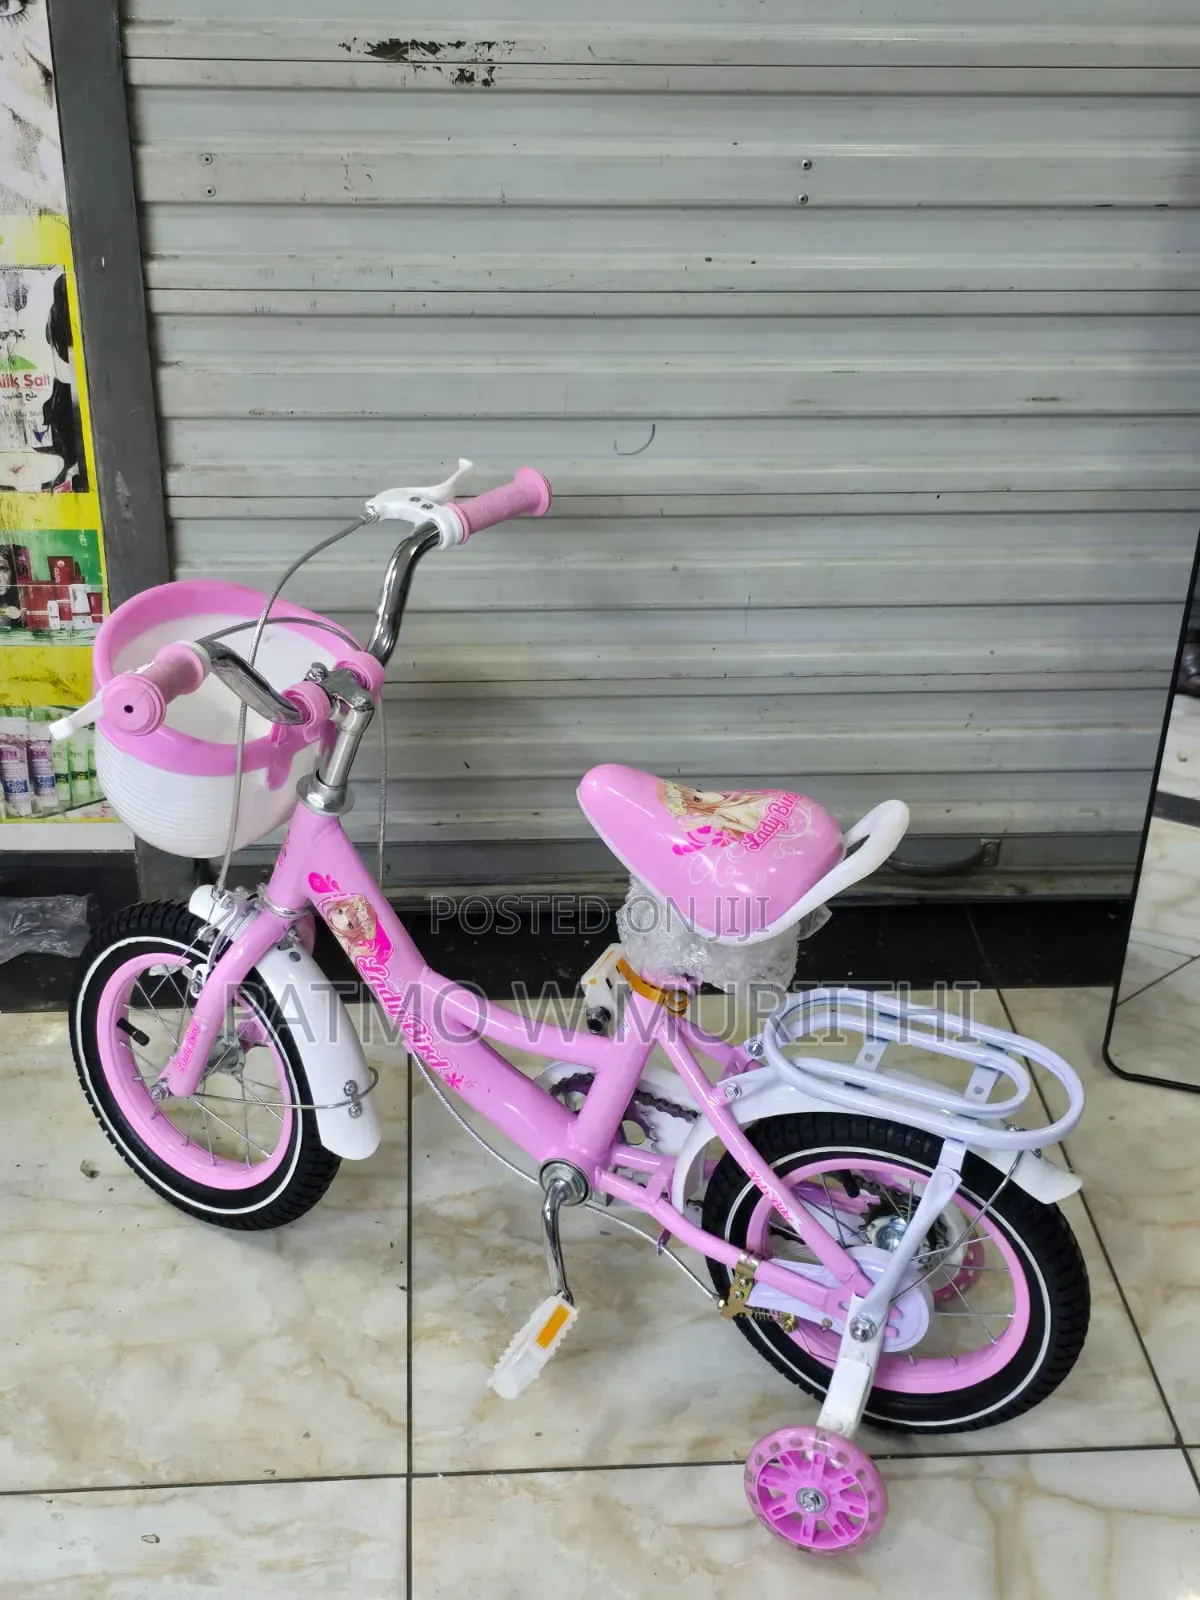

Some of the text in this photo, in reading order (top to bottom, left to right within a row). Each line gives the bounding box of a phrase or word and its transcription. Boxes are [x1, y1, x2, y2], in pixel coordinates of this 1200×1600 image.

[24, 372, 51, 388] Salt
[741, 816, 788, 852] Lady
[356, 955, 453, 1070] Lady Bird
